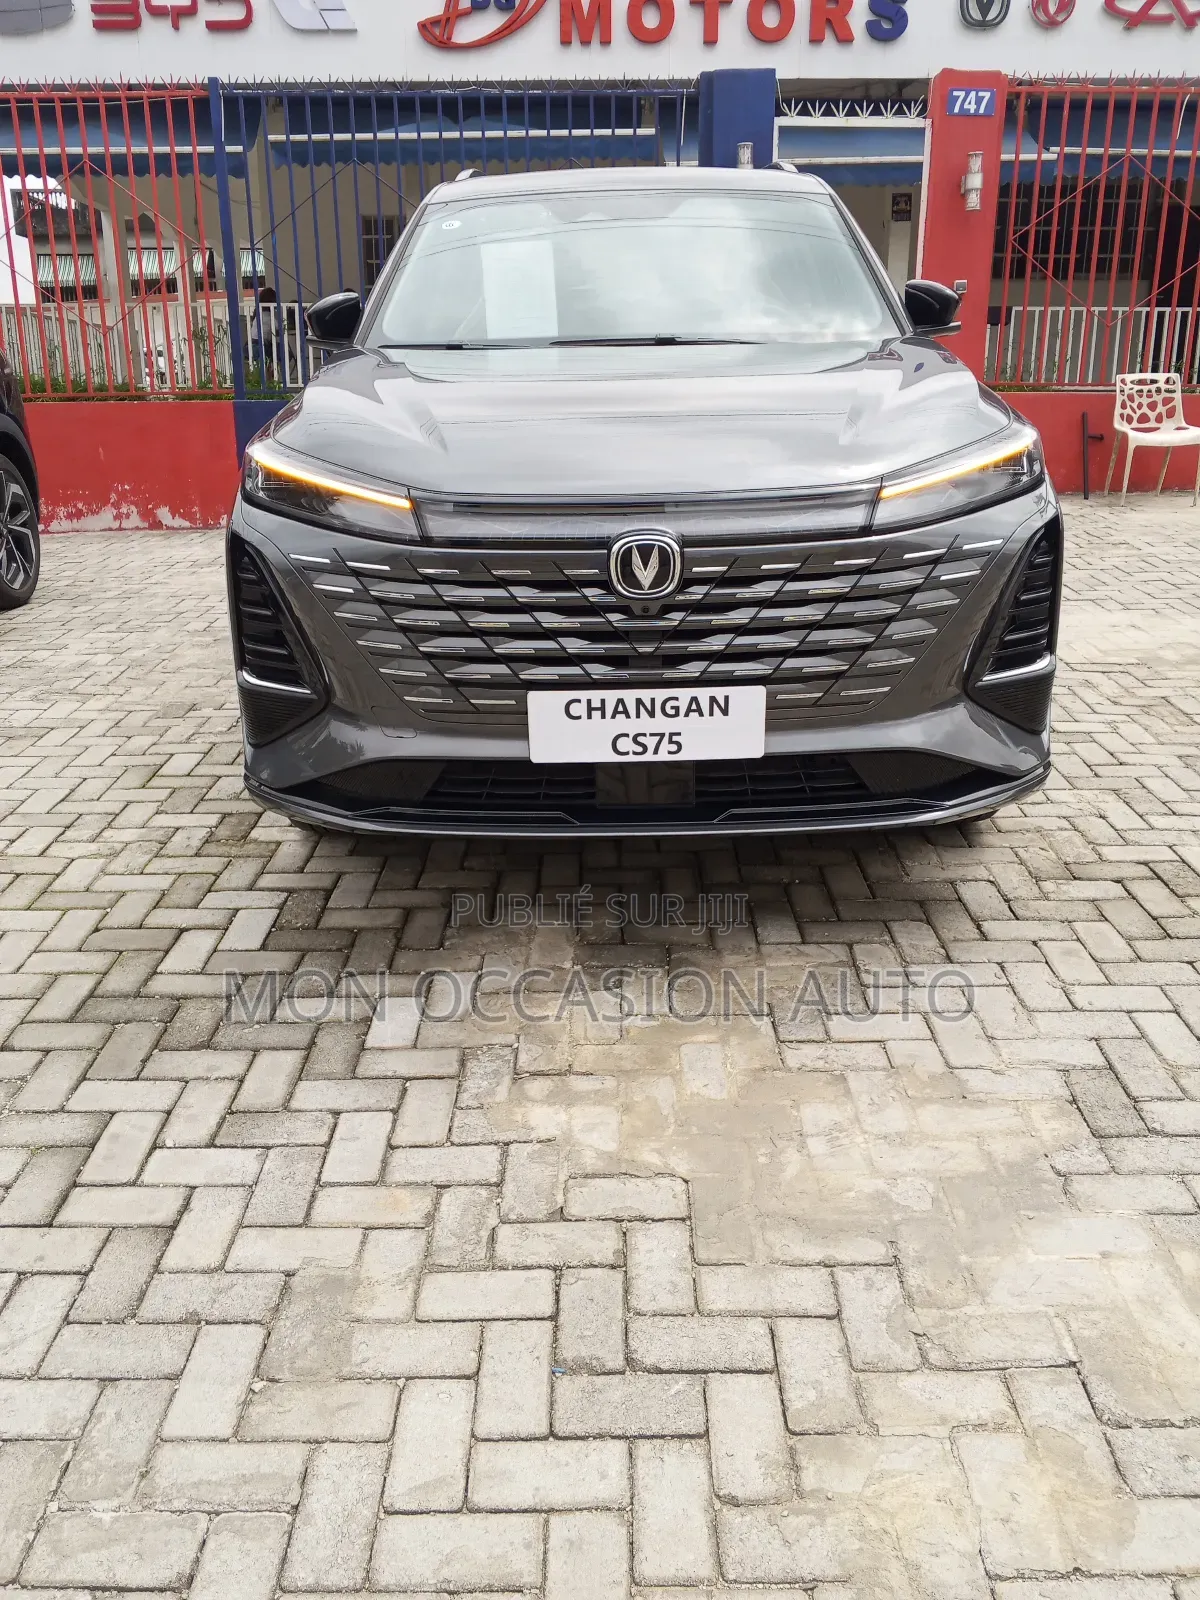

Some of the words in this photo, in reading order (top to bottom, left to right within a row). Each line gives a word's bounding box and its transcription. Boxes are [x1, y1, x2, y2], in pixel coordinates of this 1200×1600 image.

[559, 0, 909, 45] MOTORS
[953, 90, 991, 114] 747
[563, 694, 730, 721] CHANGAN
[611, 732, 683, 756] CS75
